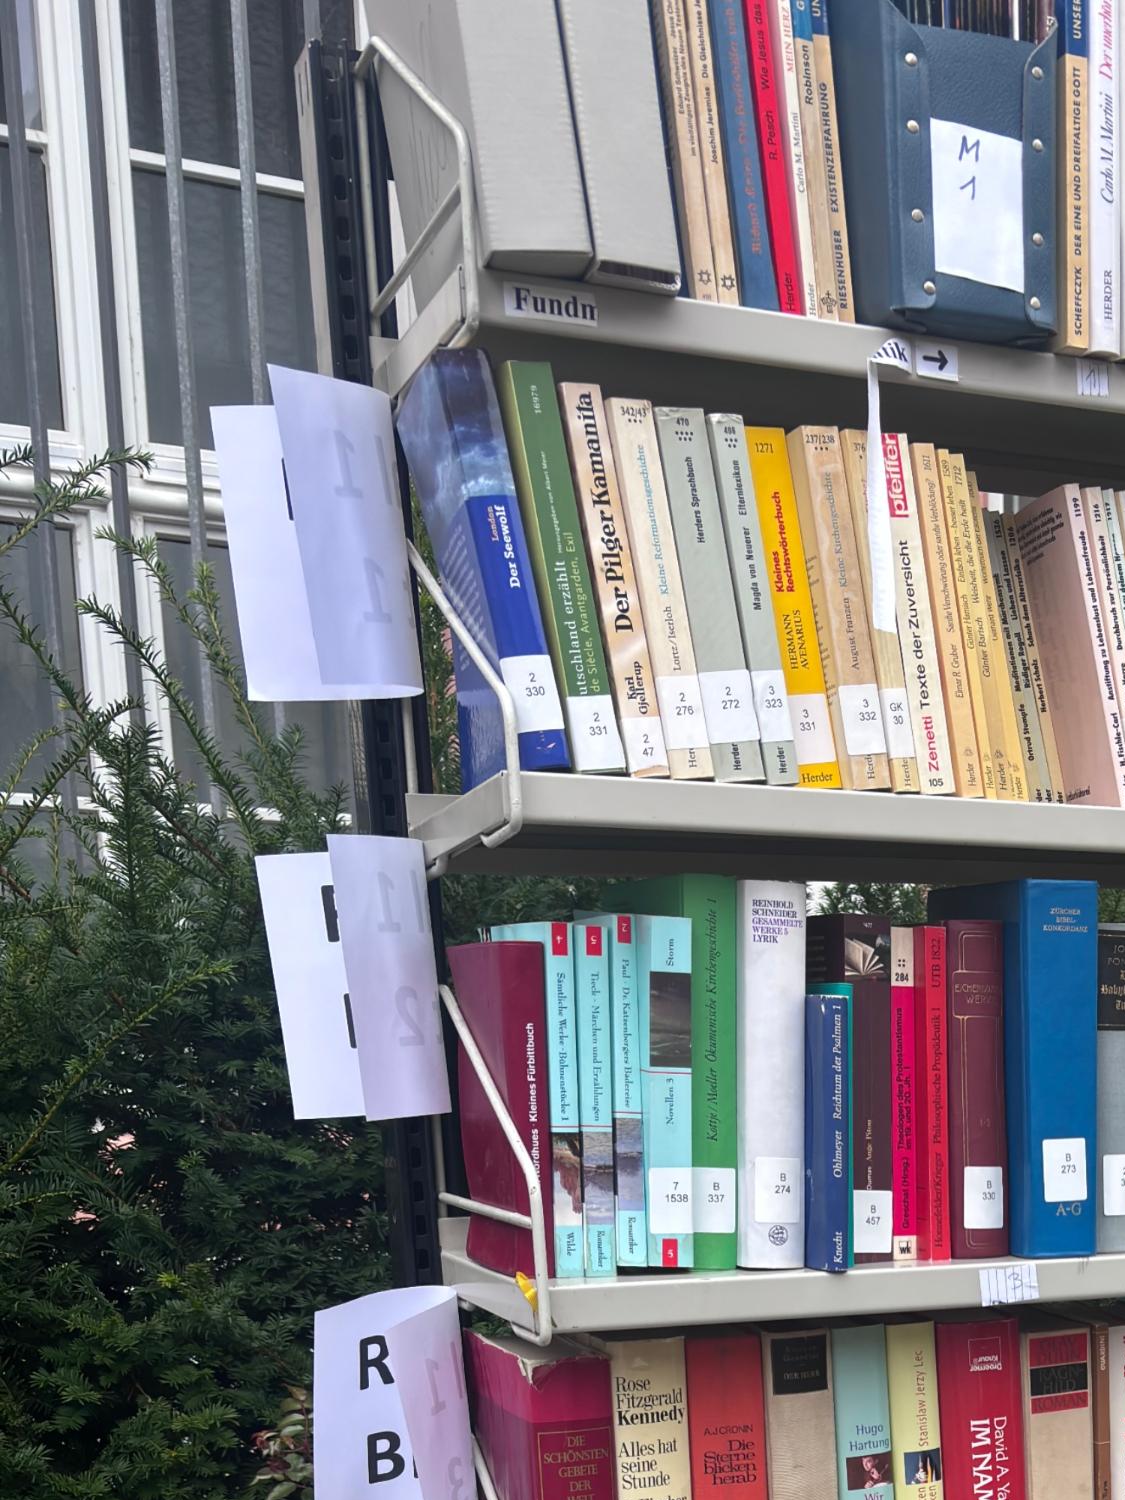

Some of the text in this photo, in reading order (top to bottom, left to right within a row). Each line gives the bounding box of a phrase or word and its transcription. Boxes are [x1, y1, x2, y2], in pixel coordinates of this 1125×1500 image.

[800, 45, 813, 105] Robinson
[957, 135, 981, 164] M
[819, 83, 848, 309] RIESENHUBER EXISTENZERFAHRUNG
[1074, 234, 1082, 256] DER
[1074, 267, 1082, 335] SCHEFFCZYK
[882, 434, 908, 516] pfeiffer
[574, 392, 634, 632] Der Pilger Kamanita
[635, 445, 669, 594] Kleine Reformationsgeschichte
[487, 506, 499, 541] London
[494, 505, 520, 588] Der Seewolf
[771, 491, 796, 593] Rechtswörterbuch
[771, 551, 784, 593] Kleines
[782, 614, 798, 670] HERMANN
[793, 609, 809, 670] AVENARIUS
[898, 540, 939, 772] Zenetti Texte der Zuversicht
[524, 685, 546, 697] 330
[625, 677, 636, 699] Karl
[632, 661, 648, 714] Gjellerup
[721, 697, 741, 709] 272
[764, 698, 783, 709] 323
[889, 702, 904, 712] GK
[858, 711, 877, 721] 332
[892, 715, 904, 725] 30
[588, 725, 608, 736] 331
[666, 939, 675, 966] Storm
[524, 1023, 539, 1122] Kleines Fürbittbuch
[666, 1086, 674, 1124] Novellen
[665, 1193, 689, 1204] 1538
[707, 1193, 725, 1203] 337
[775, 1184, 791, 1194] 274
[865, 1216, 881, 1226] 457
[616, 1377, 651, 1393] Rose
[616, 1386, 683, 1409] Fitzgerald
[618, 1407, 685, 1426] Kennedy
[856, 1424, 884, 1434] Hugo
[971, 1419, 991, 1442] IM
[994, 1416, 1008, 1451] David
[618, 1439, 677, 1458] Alles hat
[728, 1441, 754, 1451] Die
[849, 1439, 890, 1451] Hartung
[620, 1460, 658, 1472] seine
[703, 1452, 756, 1463] Sterne
[703, 1463, 757, 1474] blicken
[622, 1474, 670, 1489] Stunde
[712, 1473, 757, 1484] herab
